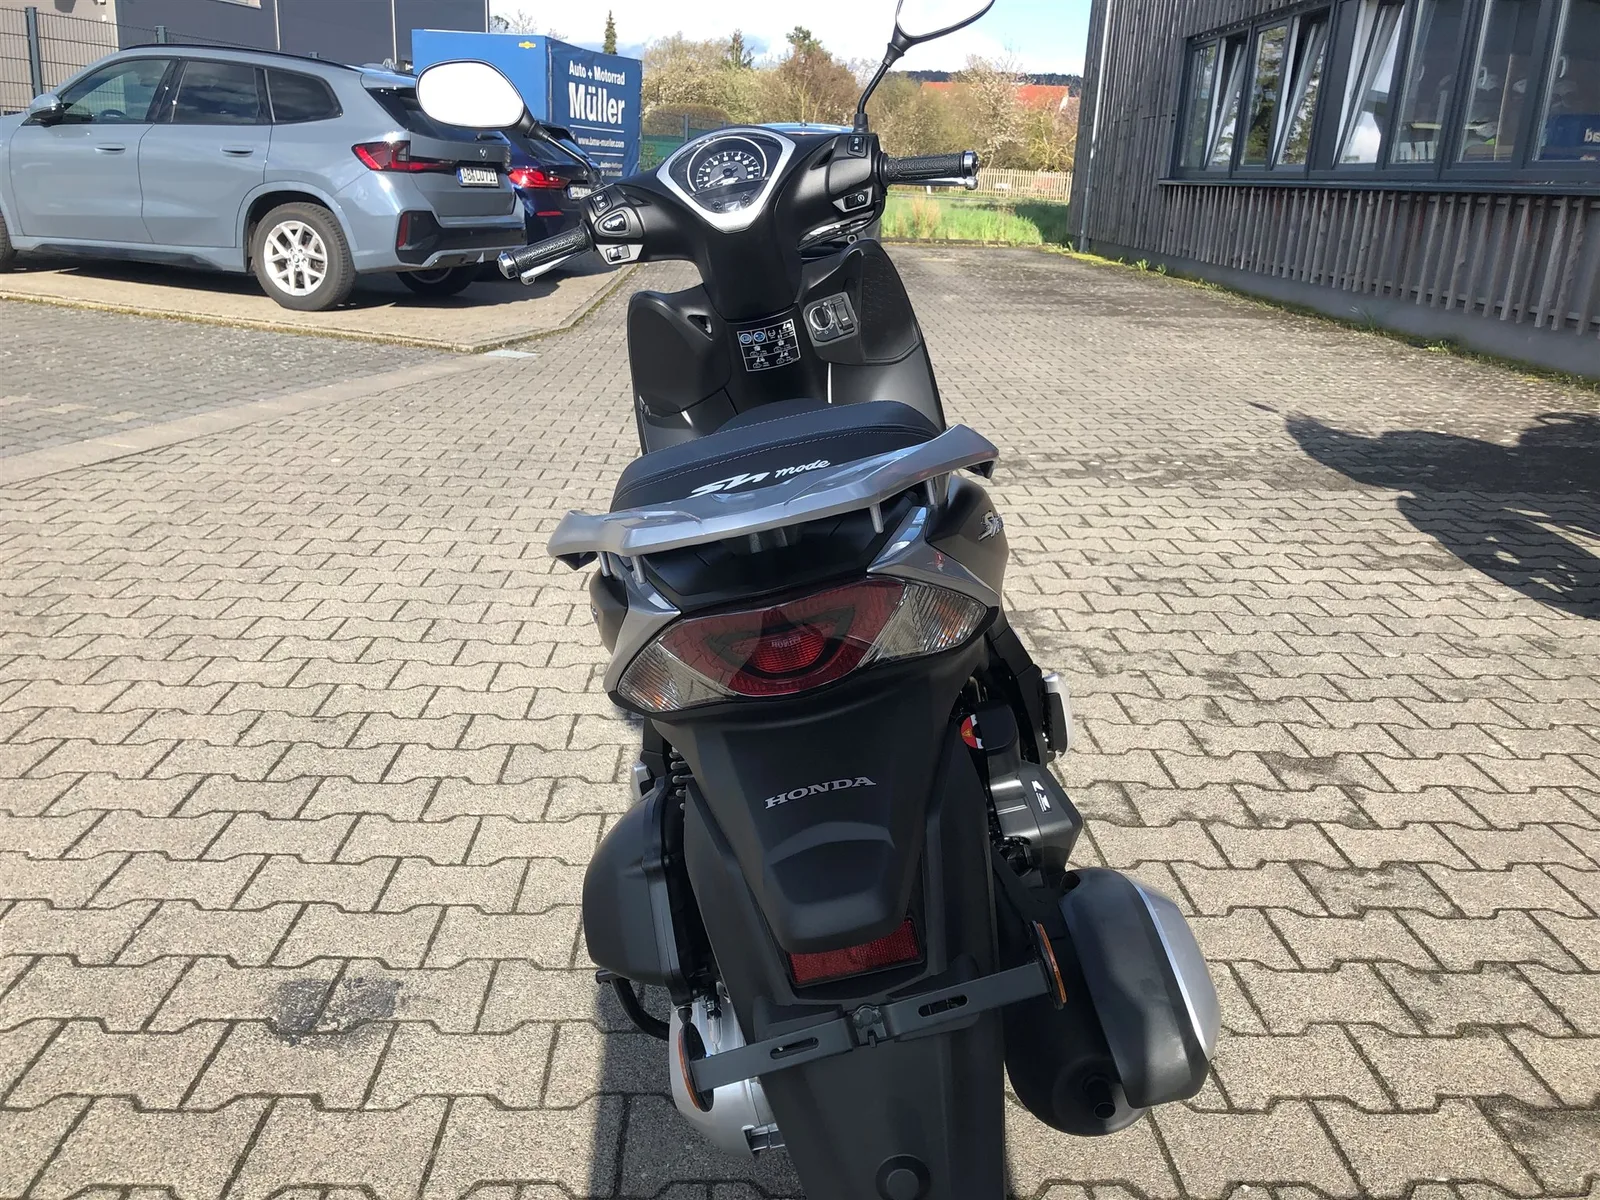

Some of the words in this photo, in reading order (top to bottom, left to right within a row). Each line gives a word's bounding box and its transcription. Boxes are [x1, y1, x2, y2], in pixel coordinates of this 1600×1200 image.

[568, 60, 587, 79] Auto
[593, 65, 626, 86] Motorrad
[568, 81, 626, 125] Müller
[774, 459, 831, 479] mode
[764, 776, 877, 809] HONDA
